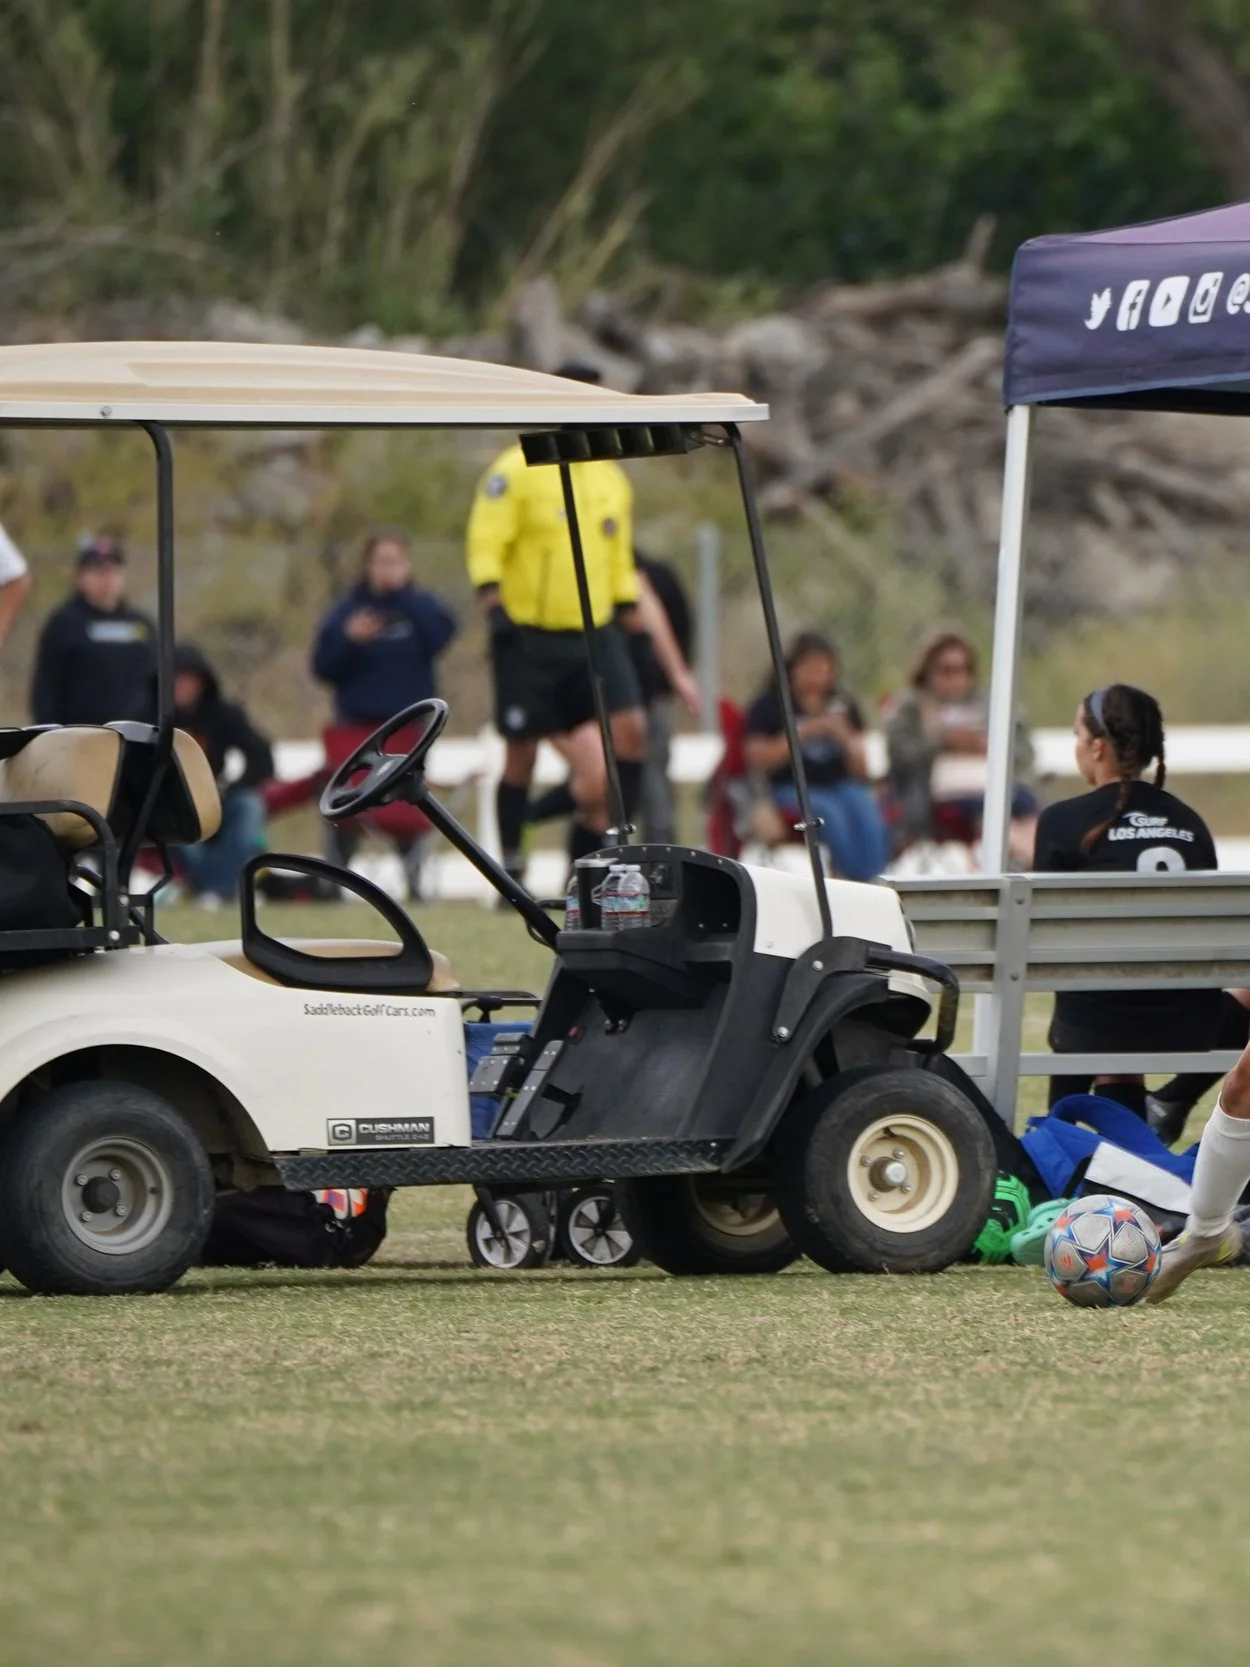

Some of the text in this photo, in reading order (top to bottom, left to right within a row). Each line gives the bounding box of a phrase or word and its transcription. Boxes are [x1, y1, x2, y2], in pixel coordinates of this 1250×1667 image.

[1107, 827, 1194, 842] LOS ANGELES
[358, 1122, 431, 1134] CUSHMAN
